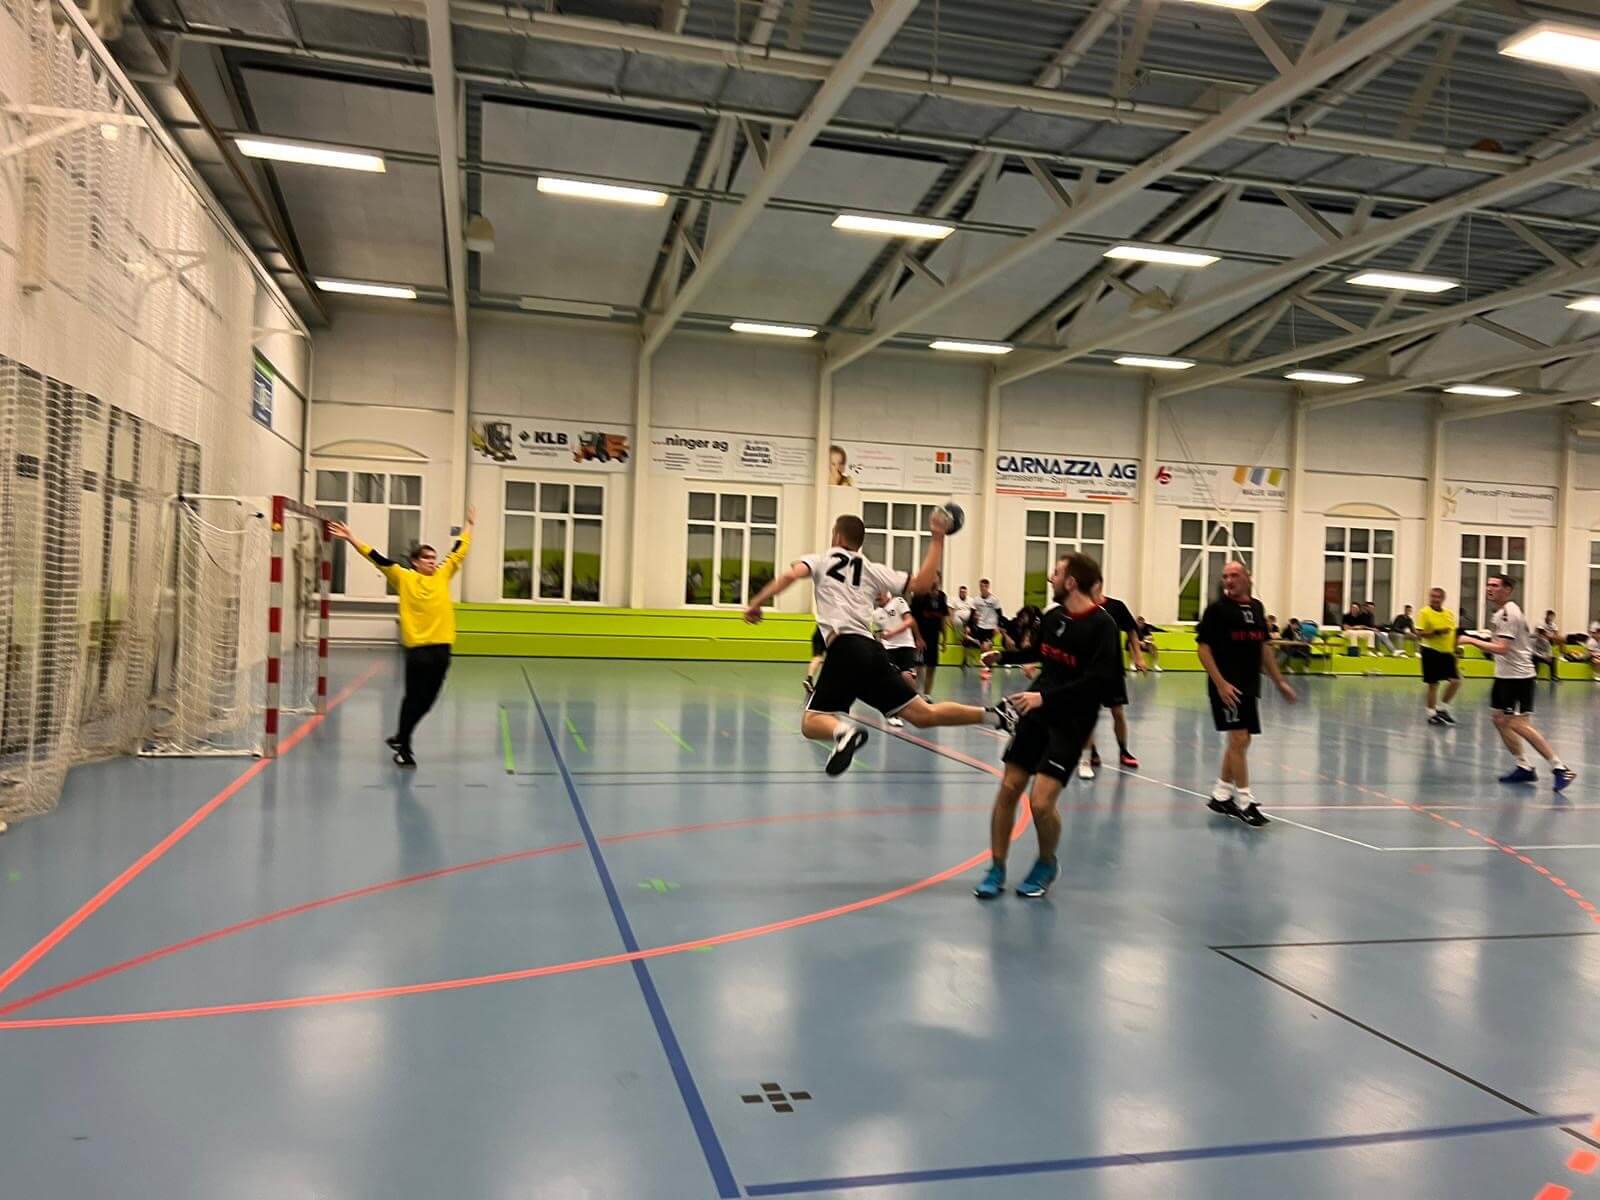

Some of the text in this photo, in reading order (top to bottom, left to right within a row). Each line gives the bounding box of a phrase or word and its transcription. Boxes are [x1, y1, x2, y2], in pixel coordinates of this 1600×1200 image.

[534, 431, 568, 445] KLB
[712, 441, 729, 452] ag
[996, 456, 1137, 480] CARNAZZA AG
[826, 553, 863, 587] 21
